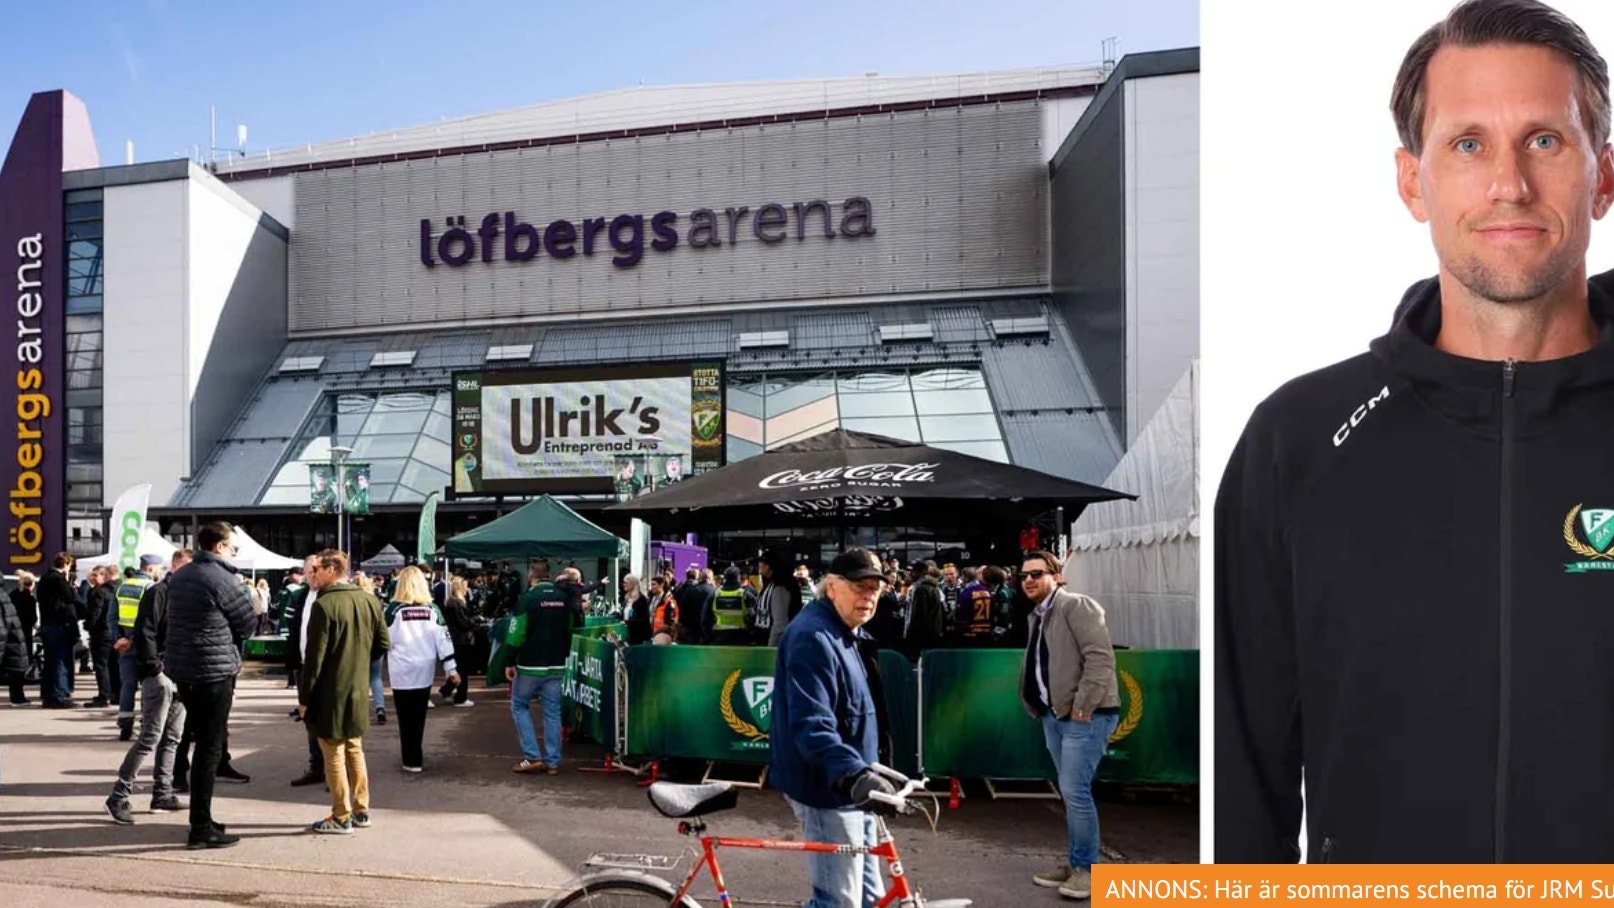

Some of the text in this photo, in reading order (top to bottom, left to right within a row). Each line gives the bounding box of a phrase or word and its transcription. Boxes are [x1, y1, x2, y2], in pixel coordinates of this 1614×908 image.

[510, 394, 661, 455] Ulrik's
[1332, 385, 1390, 447] CCM
[543, 438, 633, 456] Entreprenad
[800, 482, 841, 491] ZERO
[974, 599, 990, 621] 21
